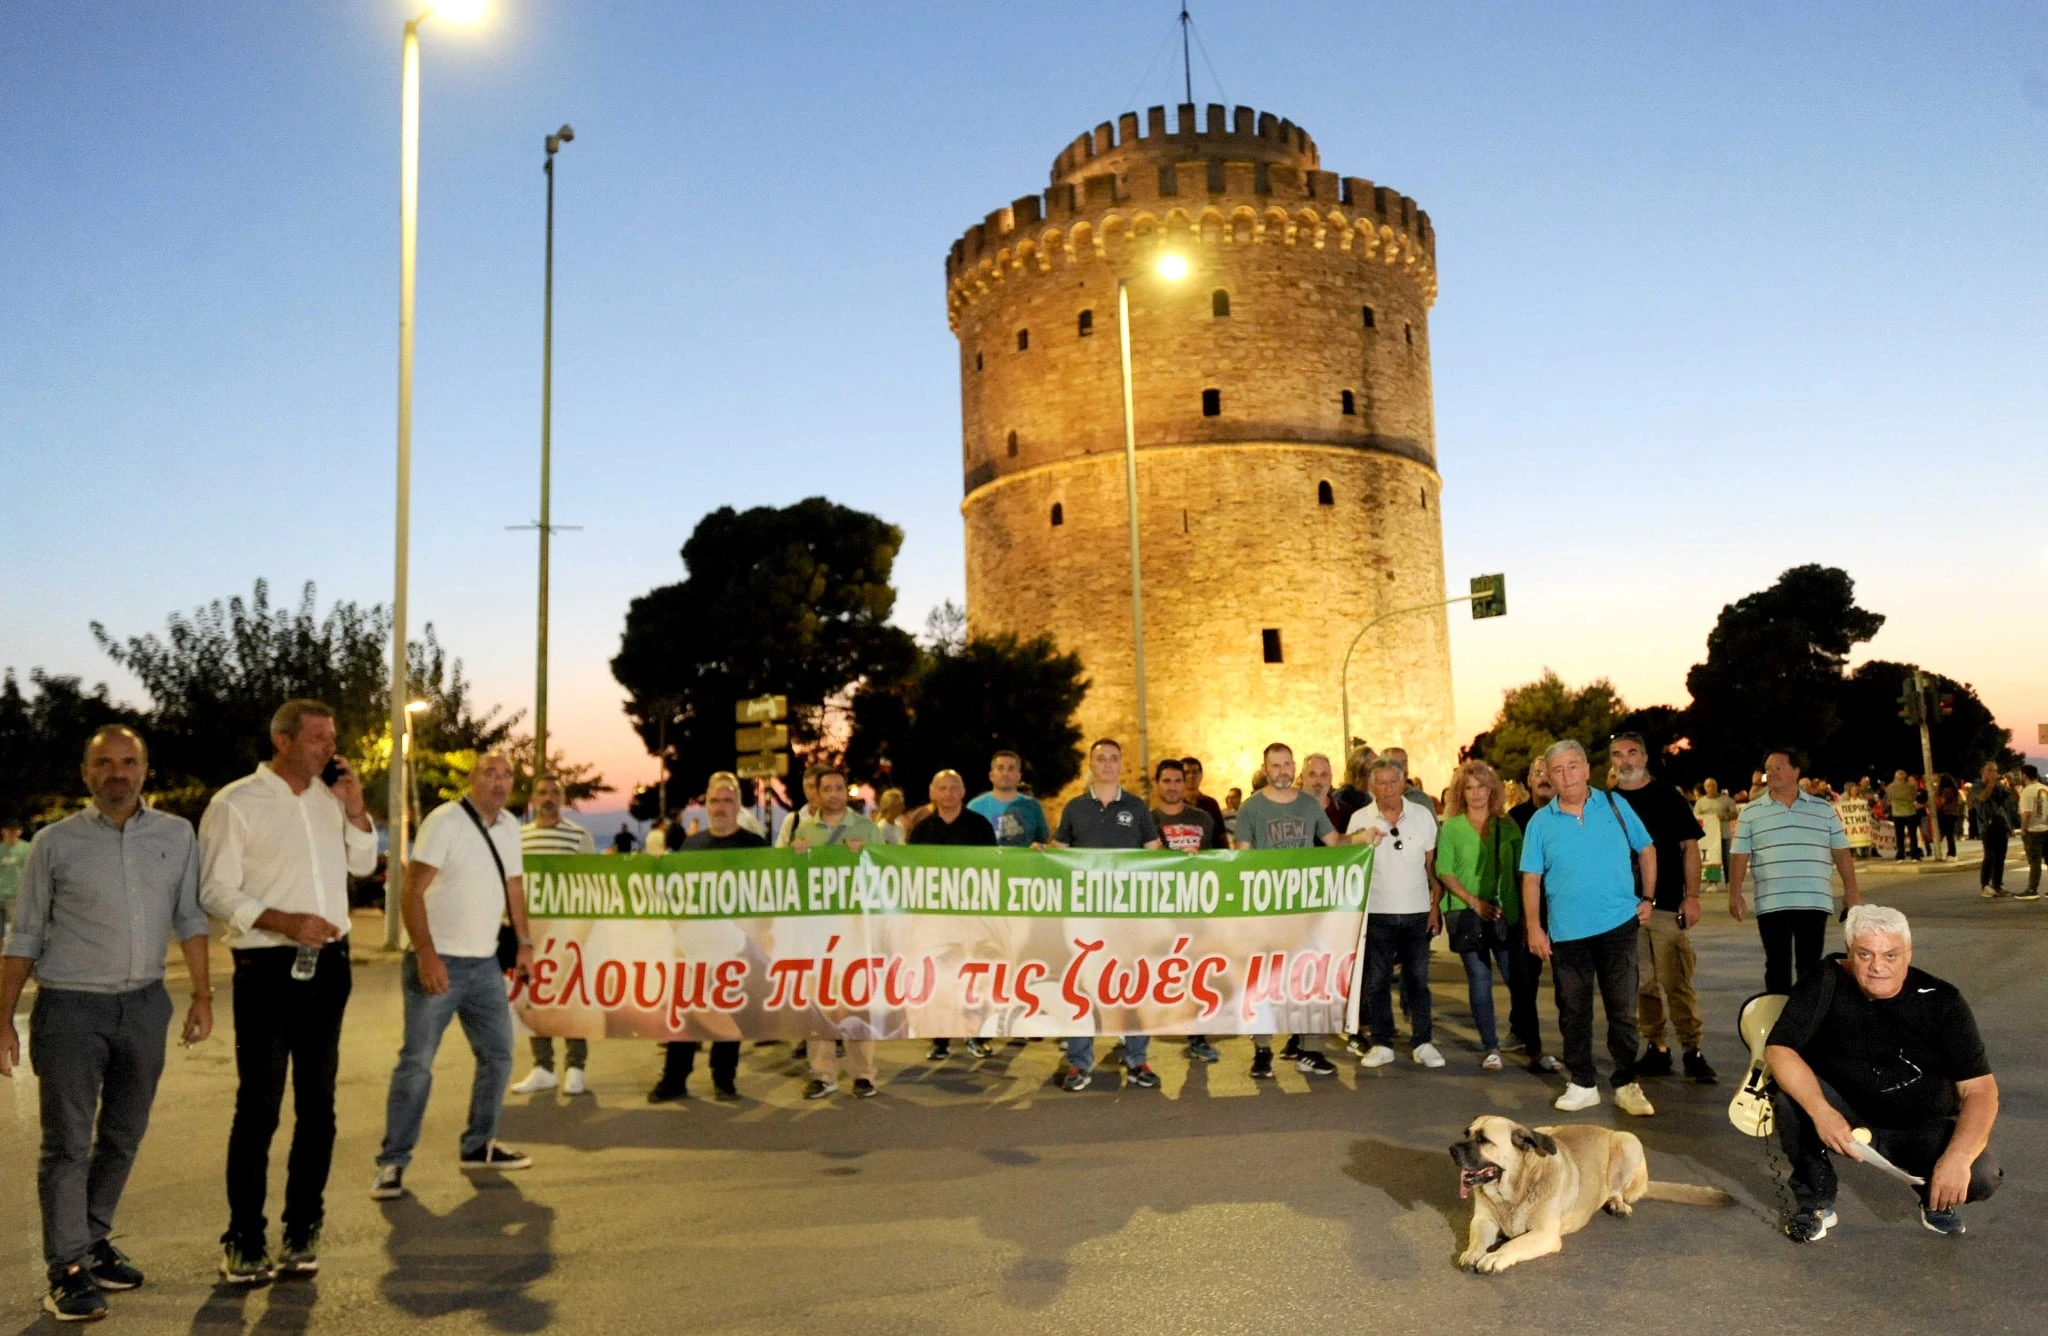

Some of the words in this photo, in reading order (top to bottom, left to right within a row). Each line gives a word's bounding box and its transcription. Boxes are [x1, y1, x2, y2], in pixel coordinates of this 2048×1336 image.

[1271, 821, 1305, 842] NEW
[627, 868, 801, 915] ΟΜΟΣΠΟΝΔΙΑ
[808, 865, 1000, 911] ΕΡΓΑΖΟΜΕΝΩΝ
[1007, 877, 1063, 913] ΣΤΟΝ
[1071, 870, 1220, 914] ΕΠΙΣΙΤΙΣΜΟ
[1239, 864, 1365, 912] ΤΟΥΡΙΣΜΟ
[767, 935, 936, 1007] πίσω
[958, 963, 1046, 1019] τις
[1062, 937, 1227, 1021] ζωές
